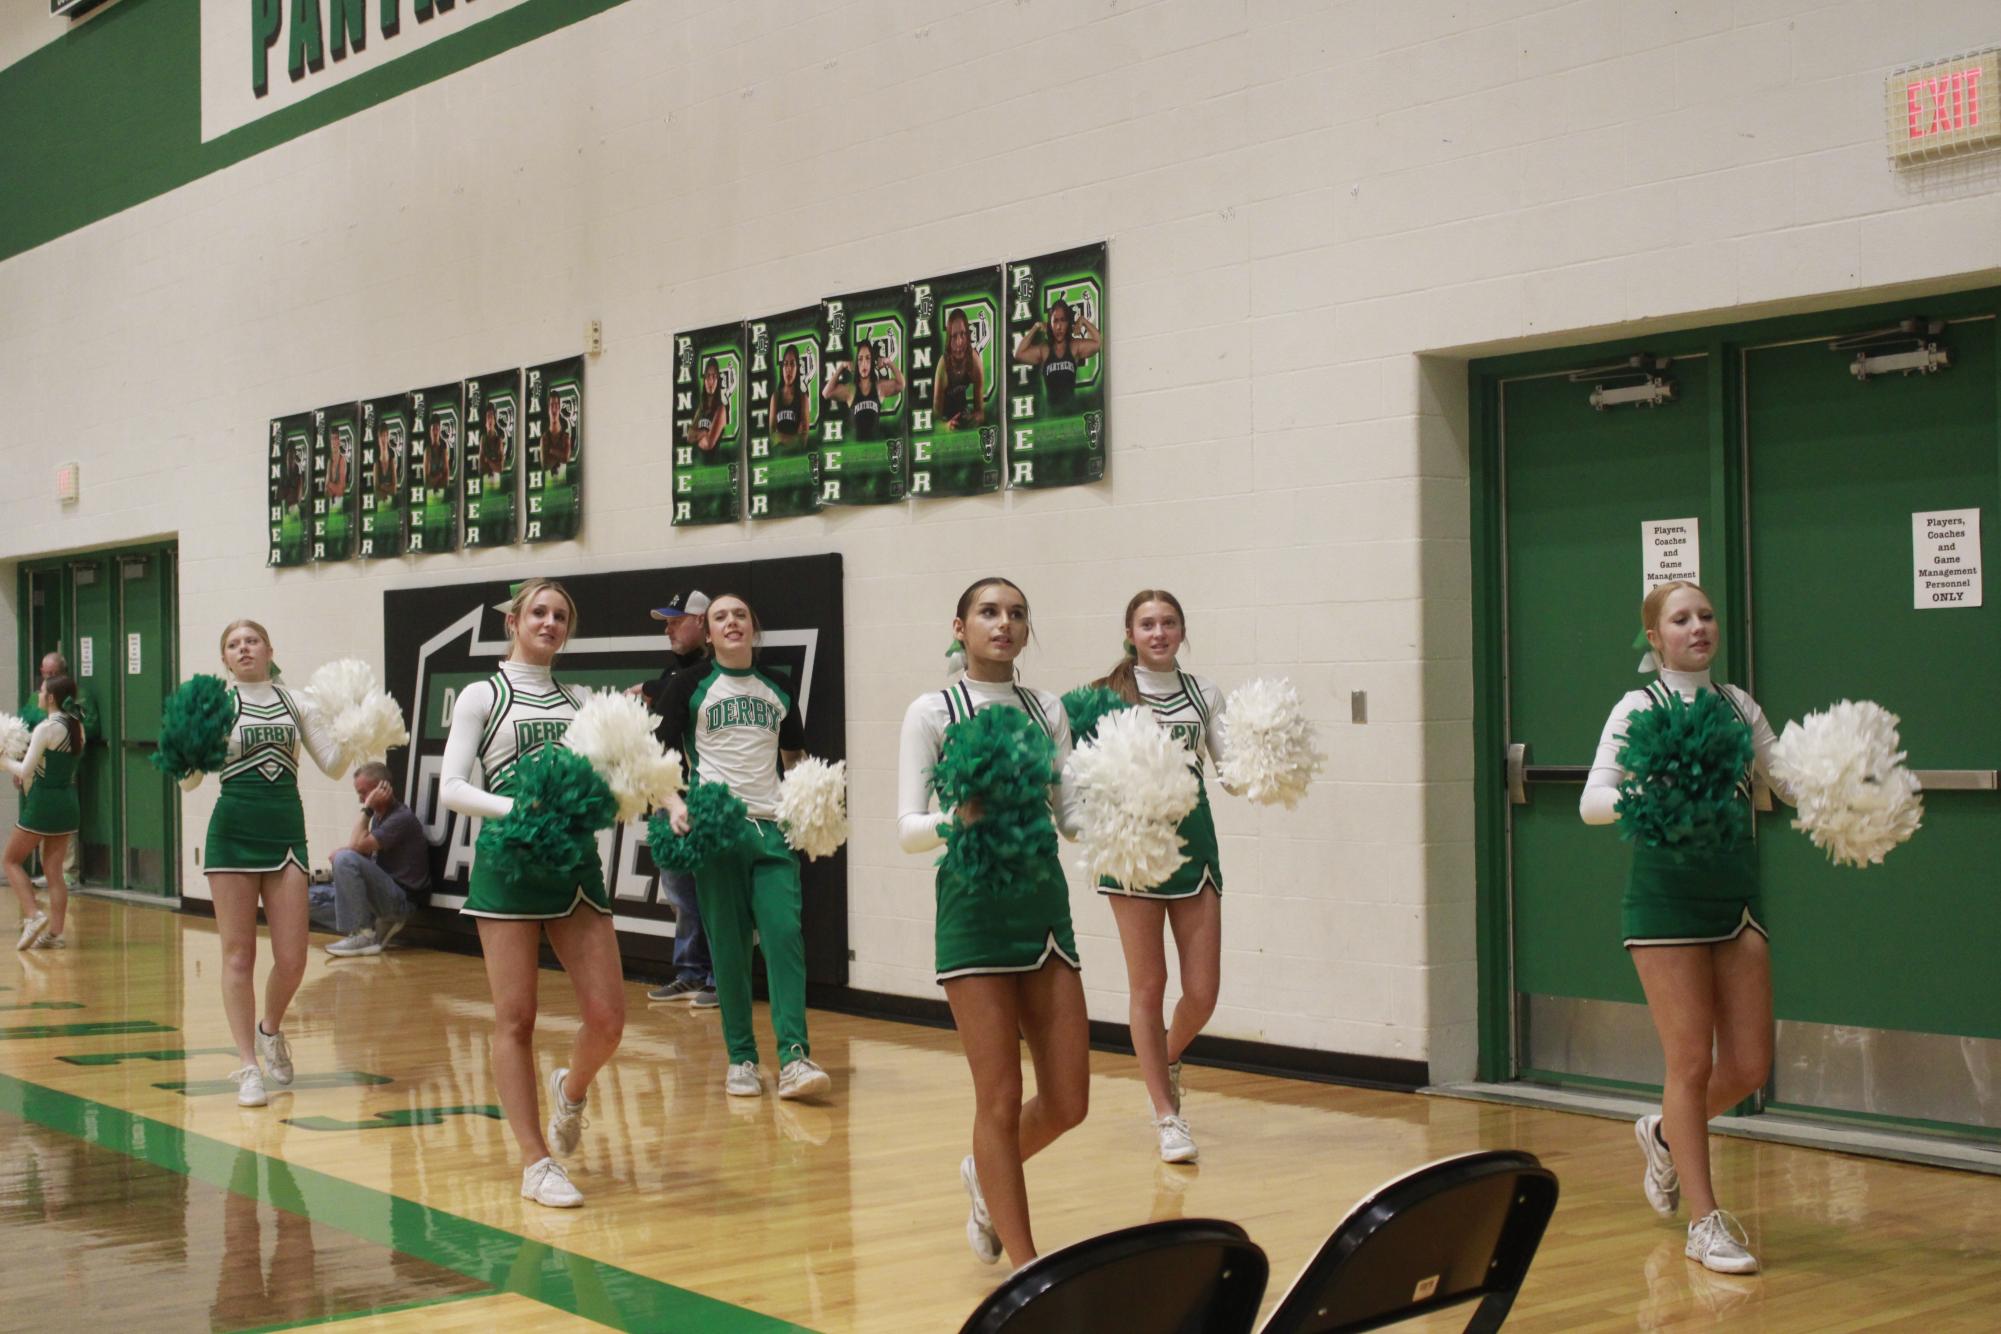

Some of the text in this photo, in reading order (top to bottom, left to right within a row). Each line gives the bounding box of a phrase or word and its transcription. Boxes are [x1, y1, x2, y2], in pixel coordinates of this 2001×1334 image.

[1906, 67, 1982, 139] EXIT
[912, 284, 932, 492] PANTHER
[676, 336, 693, 520] PANTHER
[751, 322, 769, 514] PANTHER
[466, 381, 480, 543] PANTHER
[528, 370, 543, 538] PANTHER
[314, 411, 325, 558] PANTHER
[361, 404, 375, 554] PANTHER
[410, 393, 424, 550] PANTHER
[271, 421, 282, 563] PANTHER
[1654, 526, 1687, 535] Players,
[1927, 518, 1965, 528] Players,
[1927, 530, 1965, 540] Coaches
[1655, 537, 1687, 546] Coaches
[1663, 549, 1678, 557] and
[1938, 543, 1956, 551] and
[1660, 561, 1682, 569] Game
[1918, 567, 1977, 578] Management
[1934, 556, 1960, 564] Game
[1647, 571, 1696, 581] Management
[1925, 579, 1970, 589] Personnel
[1932, 592, 1964, 602] ONLY
[706, 695, 781, 735] DERBY
[243, 726, 294, 753] DERBY
[518, 721, 571, 754] DERB
